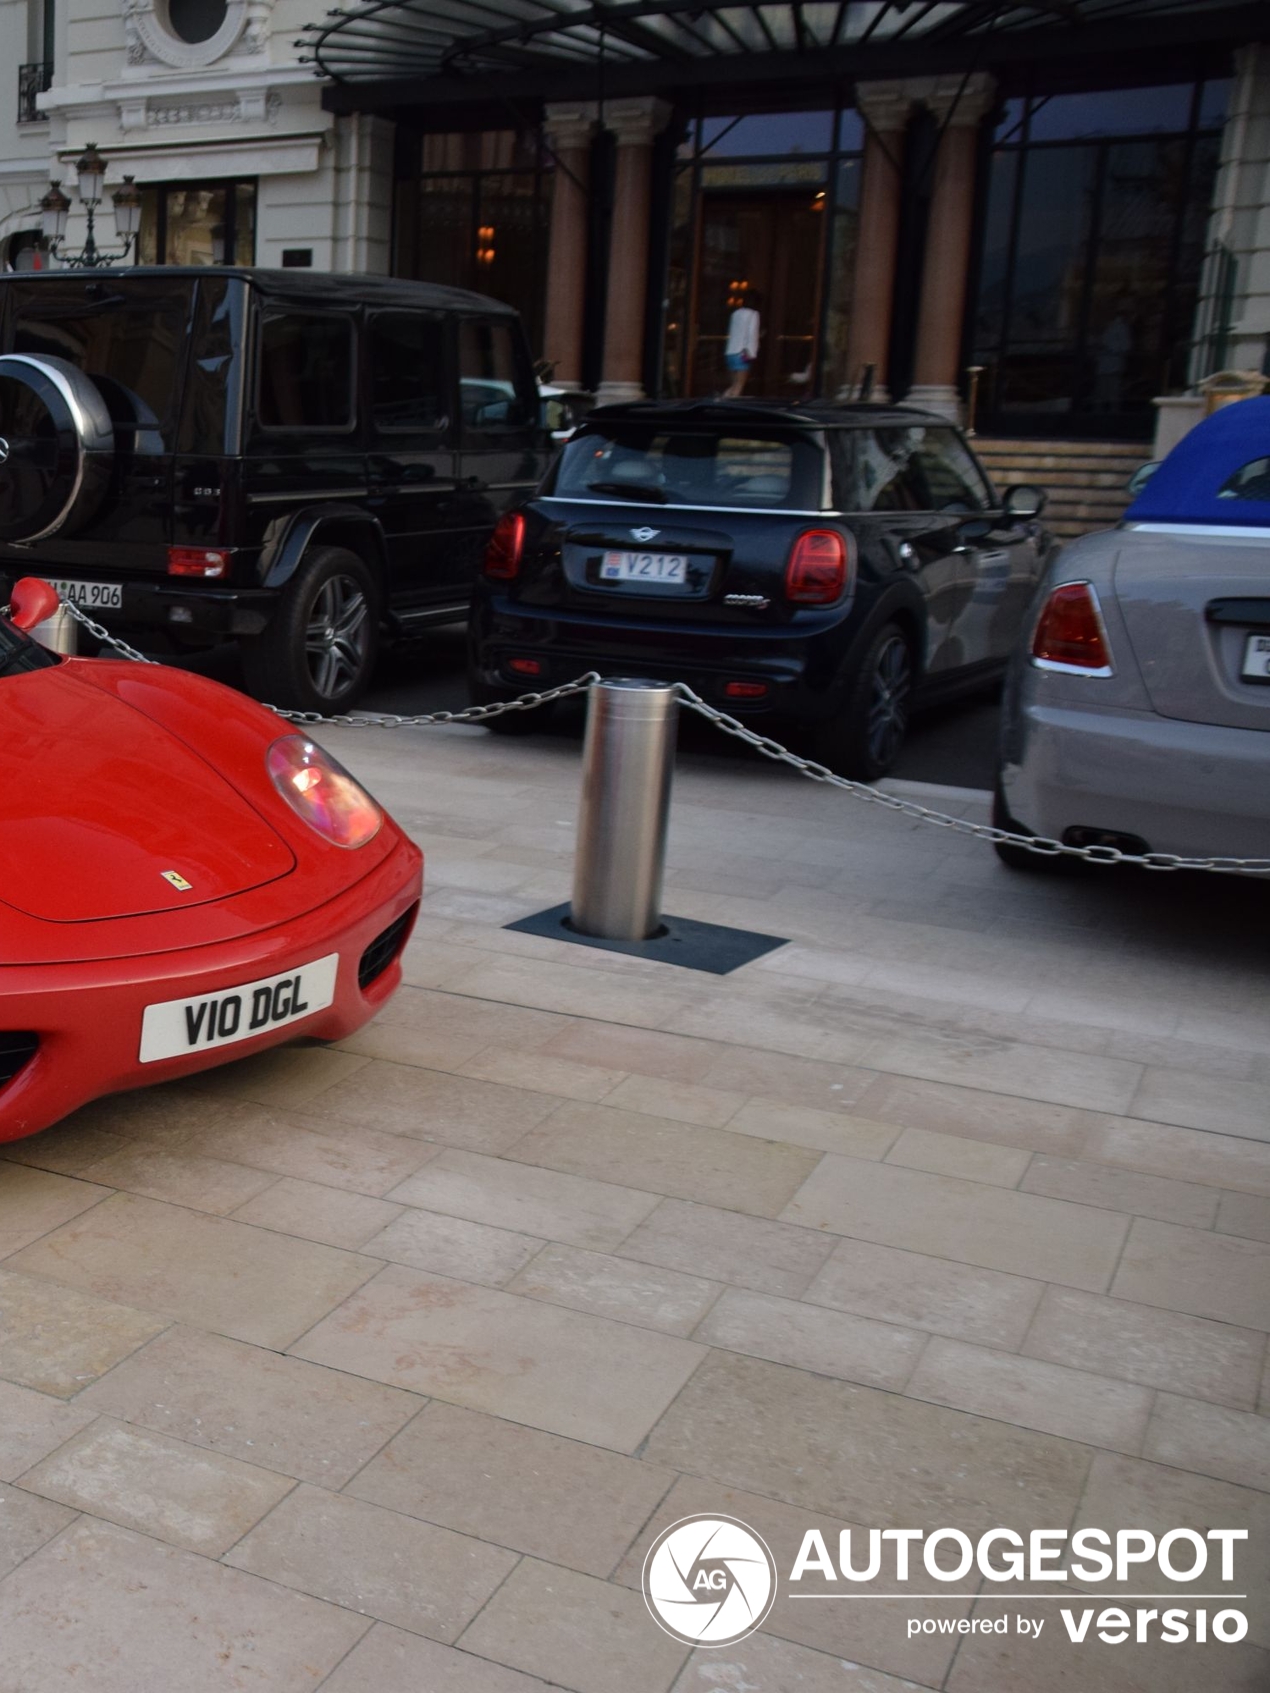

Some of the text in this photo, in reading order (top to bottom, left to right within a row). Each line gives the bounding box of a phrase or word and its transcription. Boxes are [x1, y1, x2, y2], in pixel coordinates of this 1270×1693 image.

[627, 554, 681, 577] V212
[91, 586, 120, 606] 906
[249, 975, 308, 1030] DGL
